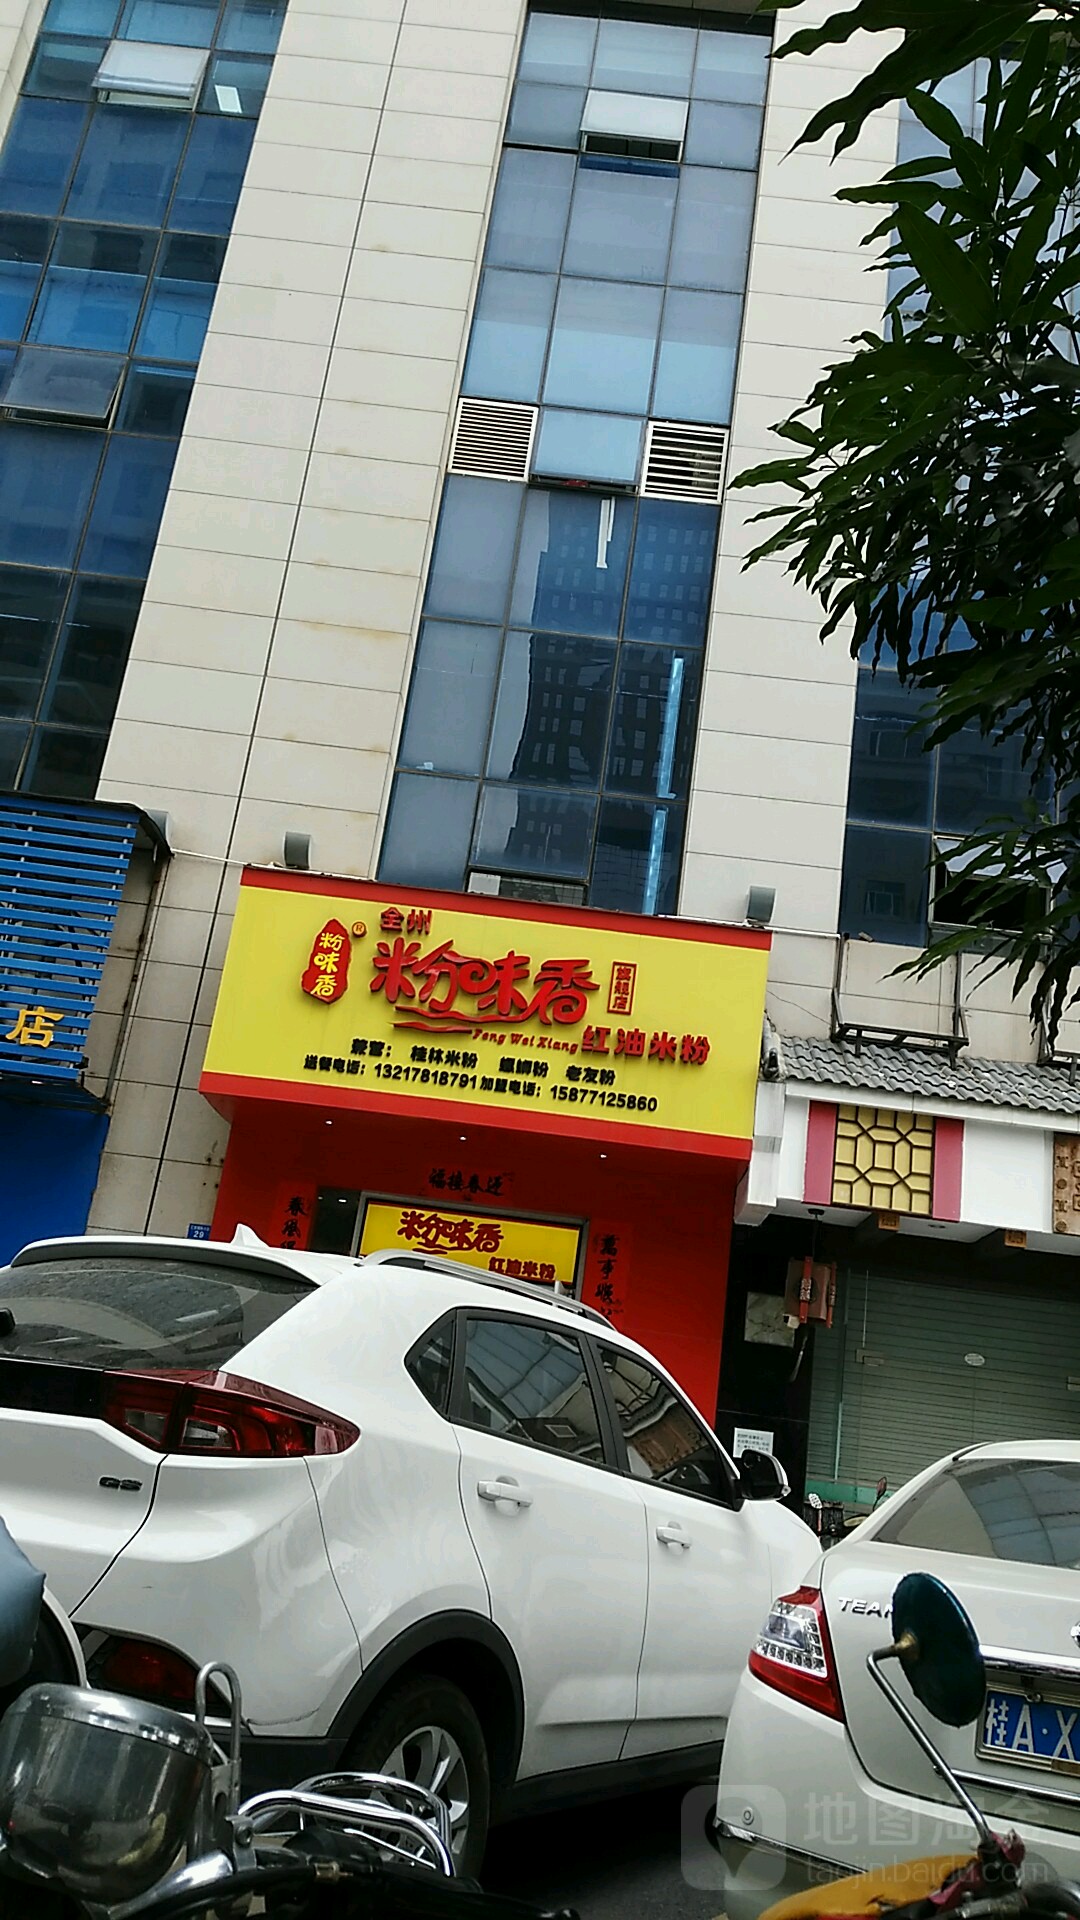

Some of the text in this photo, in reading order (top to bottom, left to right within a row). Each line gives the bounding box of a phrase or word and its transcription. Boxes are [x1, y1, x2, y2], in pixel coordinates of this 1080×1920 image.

[380, 906, 433, 936] 全州
[310, 931, 346, 997] 粉味香
[369, 936, 601, 1026] 粉味香
[611, 965, 632, 1012] 旗舰店
[5, 1006, 65, 1048] 店
[510, 1032, 536, 1047] Wei
[536, 1035, 579, 1055] Xiang
[580, 1024, 711, 1066] 红油米粉
[410, 1045, 478, 1069] 桂林米粉
[565, 1065, 616, 1086] 老友粉
[193, 1230, 205, 1239] 29
[397, 1210, 505, 1254] 粉味香
[488, 1256, 556, 1280] 红油米粉
[98, 1475, 143, 1491] GS
